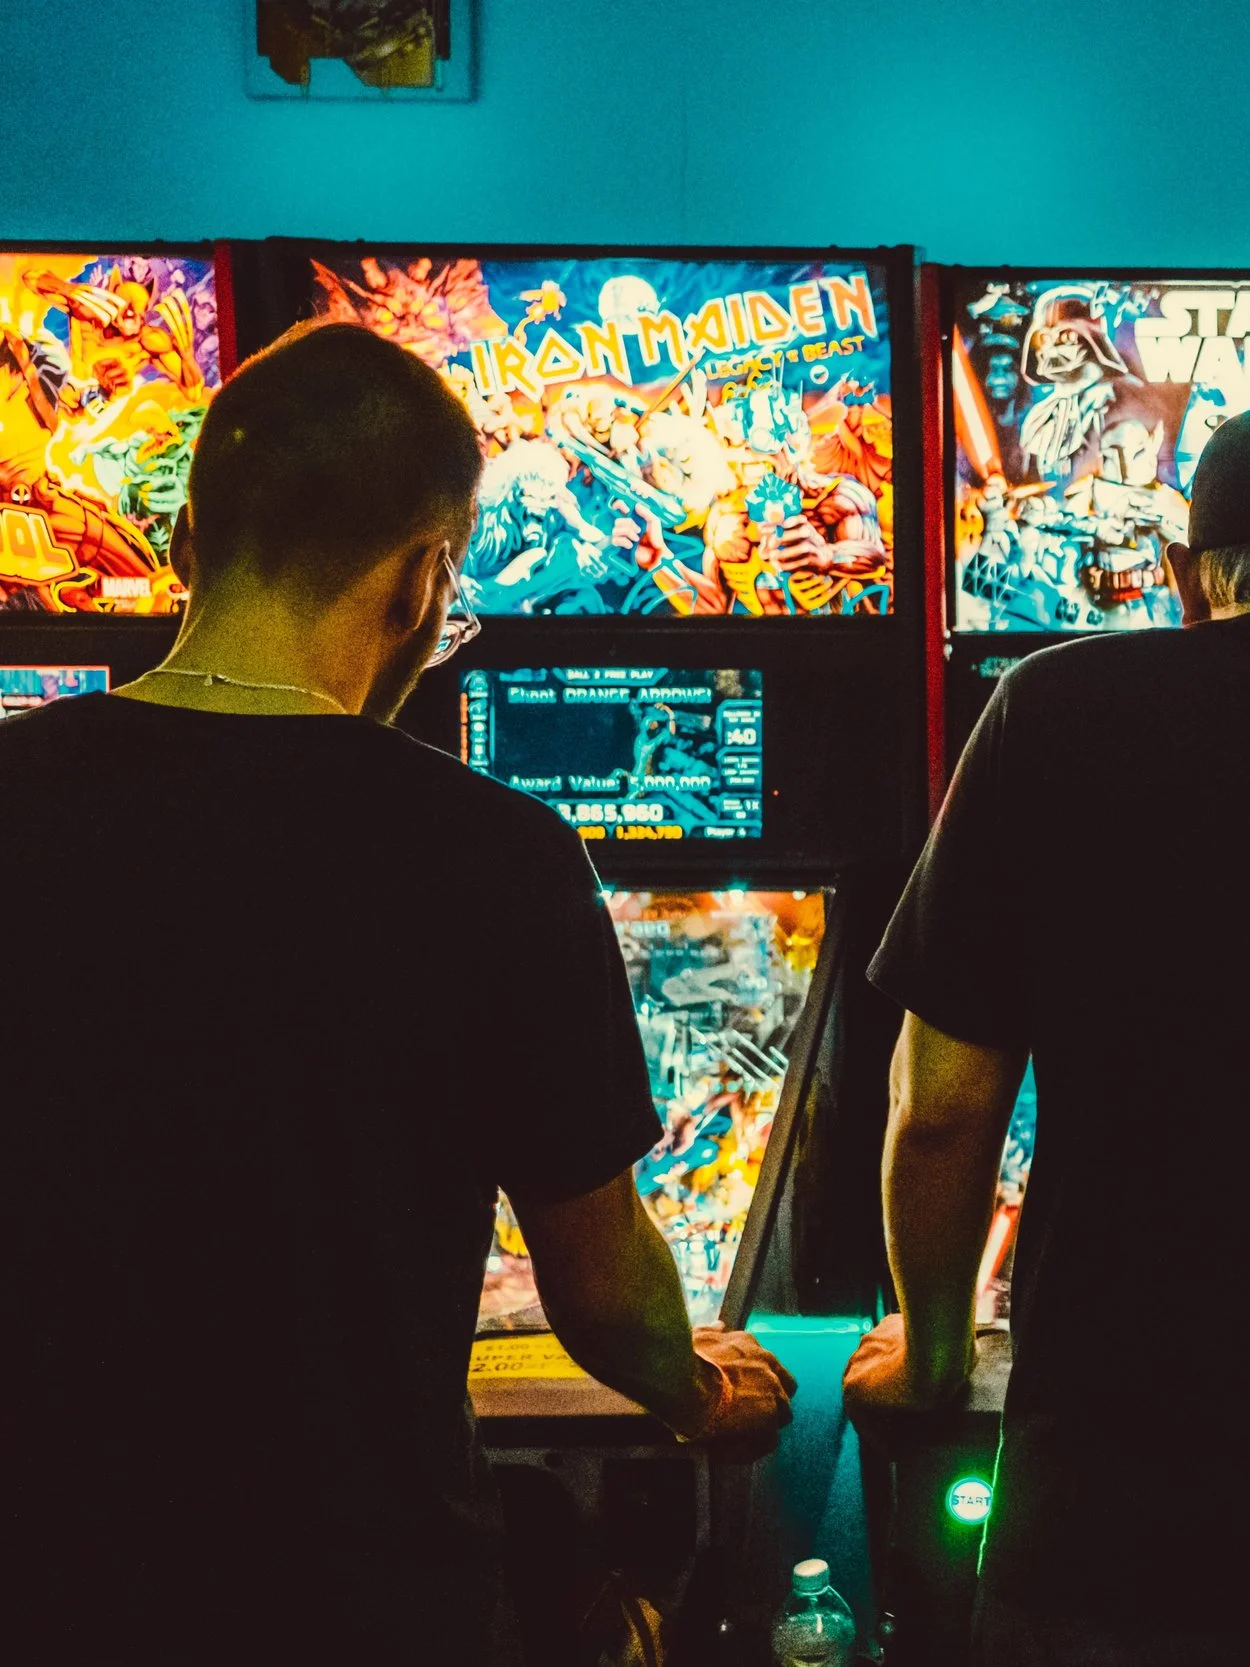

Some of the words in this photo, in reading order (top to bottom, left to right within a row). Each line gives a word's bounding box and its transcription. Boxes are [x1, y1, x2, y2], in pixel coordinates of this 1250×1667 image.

[471, 321, 633, 402] IRON
[638, 271, 879, 368] MAIDEN
[705, 350, 784, 380] LEGACY
[802, 335, 865, 362] BEAST
[0, 506, 75, 576] OL
[102, 577, 151, 597] MARVEL
[475, 1353, 533, 1362] UPER
[951, 1495, 992, 1506] START
